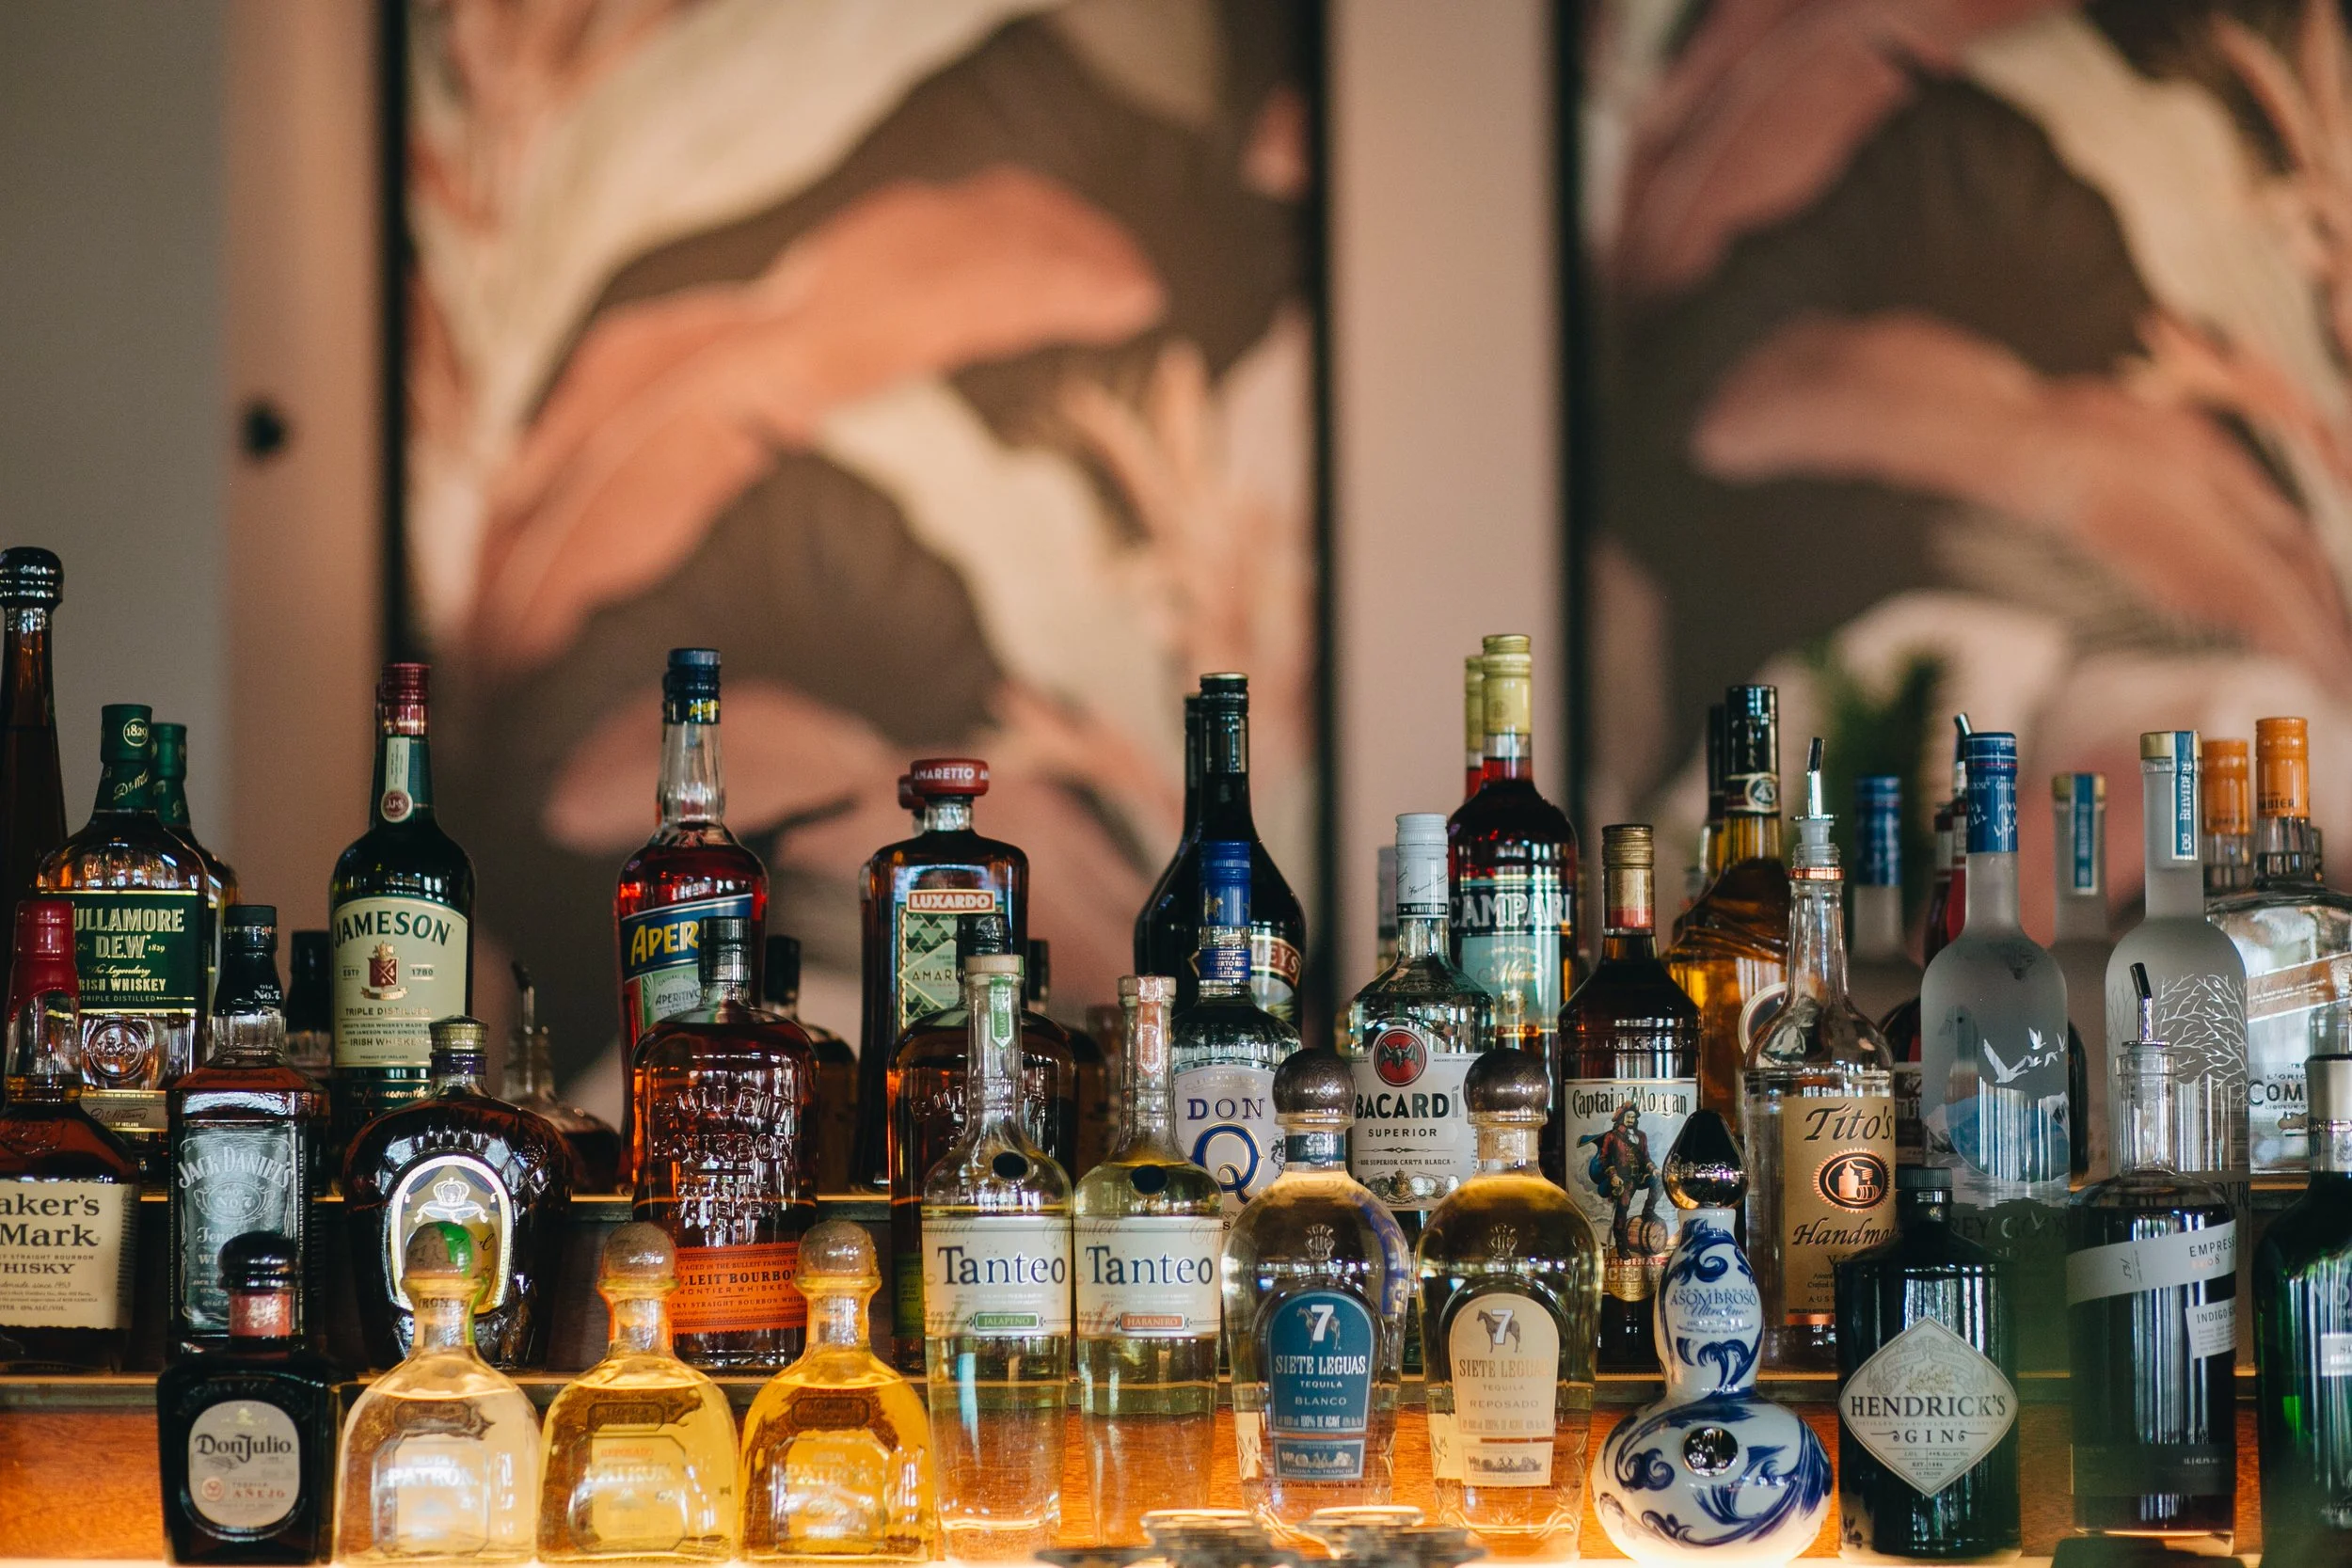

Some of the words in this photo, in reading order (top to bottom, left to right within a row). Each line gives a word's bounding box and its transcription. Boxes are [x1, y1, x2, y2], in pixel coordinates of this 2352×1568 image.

[914, 767, 976, 781] AMARETTO
[911, 895, 991, 910] LUXARDO
[1410, 904, 1432, 914] WHITE
[1448, 892, 1572, 928] CAMPARI
[73, 908, 185, 933] ULLAMORE
[334, 911, 452, 950] JAMESON
[629, 920, 700, 968] APER
[1269, 944, 1299, 974] EYS
[106, 965, 151, 978] Legendary
[411, 968, 435, 976] 1780
[911, 968, 953, 982] AMAR
[78, 977, 106, 992] RISH
[110, 977, 167, 991] WHISKEY
[81, 994, 111, 1003] TRIPLE
[113, 994, 156, 1003] DISTILLED
[345, 1007, 374, 1017] TRIPLE
[349, 1037, 373, 1047] IRISH
[2248, 1078, 2304, 1107] COM
[1186, 1097, 1266, 1121] DON
[1572, 1086, 1628, 1120] Captain
[1627, 1085, 1688, 1119] Morgan
[1804, 1102, 1893, 1142] Tito's
[1367, 1128, 1438, 1137] SUPERIOR
[177, 1154, 221, 1189] JACK
[222, 1146, 294, 1189] DANIEL'S
[1191, 1122, 1265, 1205] Q
[0, 1193, 101, 1217] aker's
[0, 1223, 98, 1247] Mark
[0, 1262, 76, 1275] HISKY
[937, 1244, 1066, 1286] Tanteo
[1085, 1244, 1214, 1286] Tanteo
[685, 1274, 722, 1287] LEIT
[738, 1283, 790, 1293] WHISKEY
[690, 1300, 735, 1308] STRAIGHT
[737, 1297, 778, 1307] BOURBON
[781, 1294, 804, 1303] WHISK
[1670, 1292, 1758, 1307] ASOMBROSO
[1127, 1316, 1179, 1327] HABANERO
[1310, 1304, 1335, 1342] 7
[2196, 1307, 2228, 1324] INDIGO
[1490, 1308, 1514, 1346] 7
[1275, 1354, 1315, 1375] SIETE
[1318, 1354, 1367, 1376] LEGUAS
[1458, 1358, 1497, 1378] SIETE
[1299, 1380, 1343, 1388] TEQUILA
[1482, 1384, 1525, 1392] TEQUILA
[1295, 1396, 1348, 1406] BLANCO
[1469, 1399, 1540, 1409] REPOSADO
[1850, 1394, 2007, 1418] HENDRICK'S
[1904, 1429, 1955, 1444] GIN
[232, 1486, 286, 1499] AÑEJO
